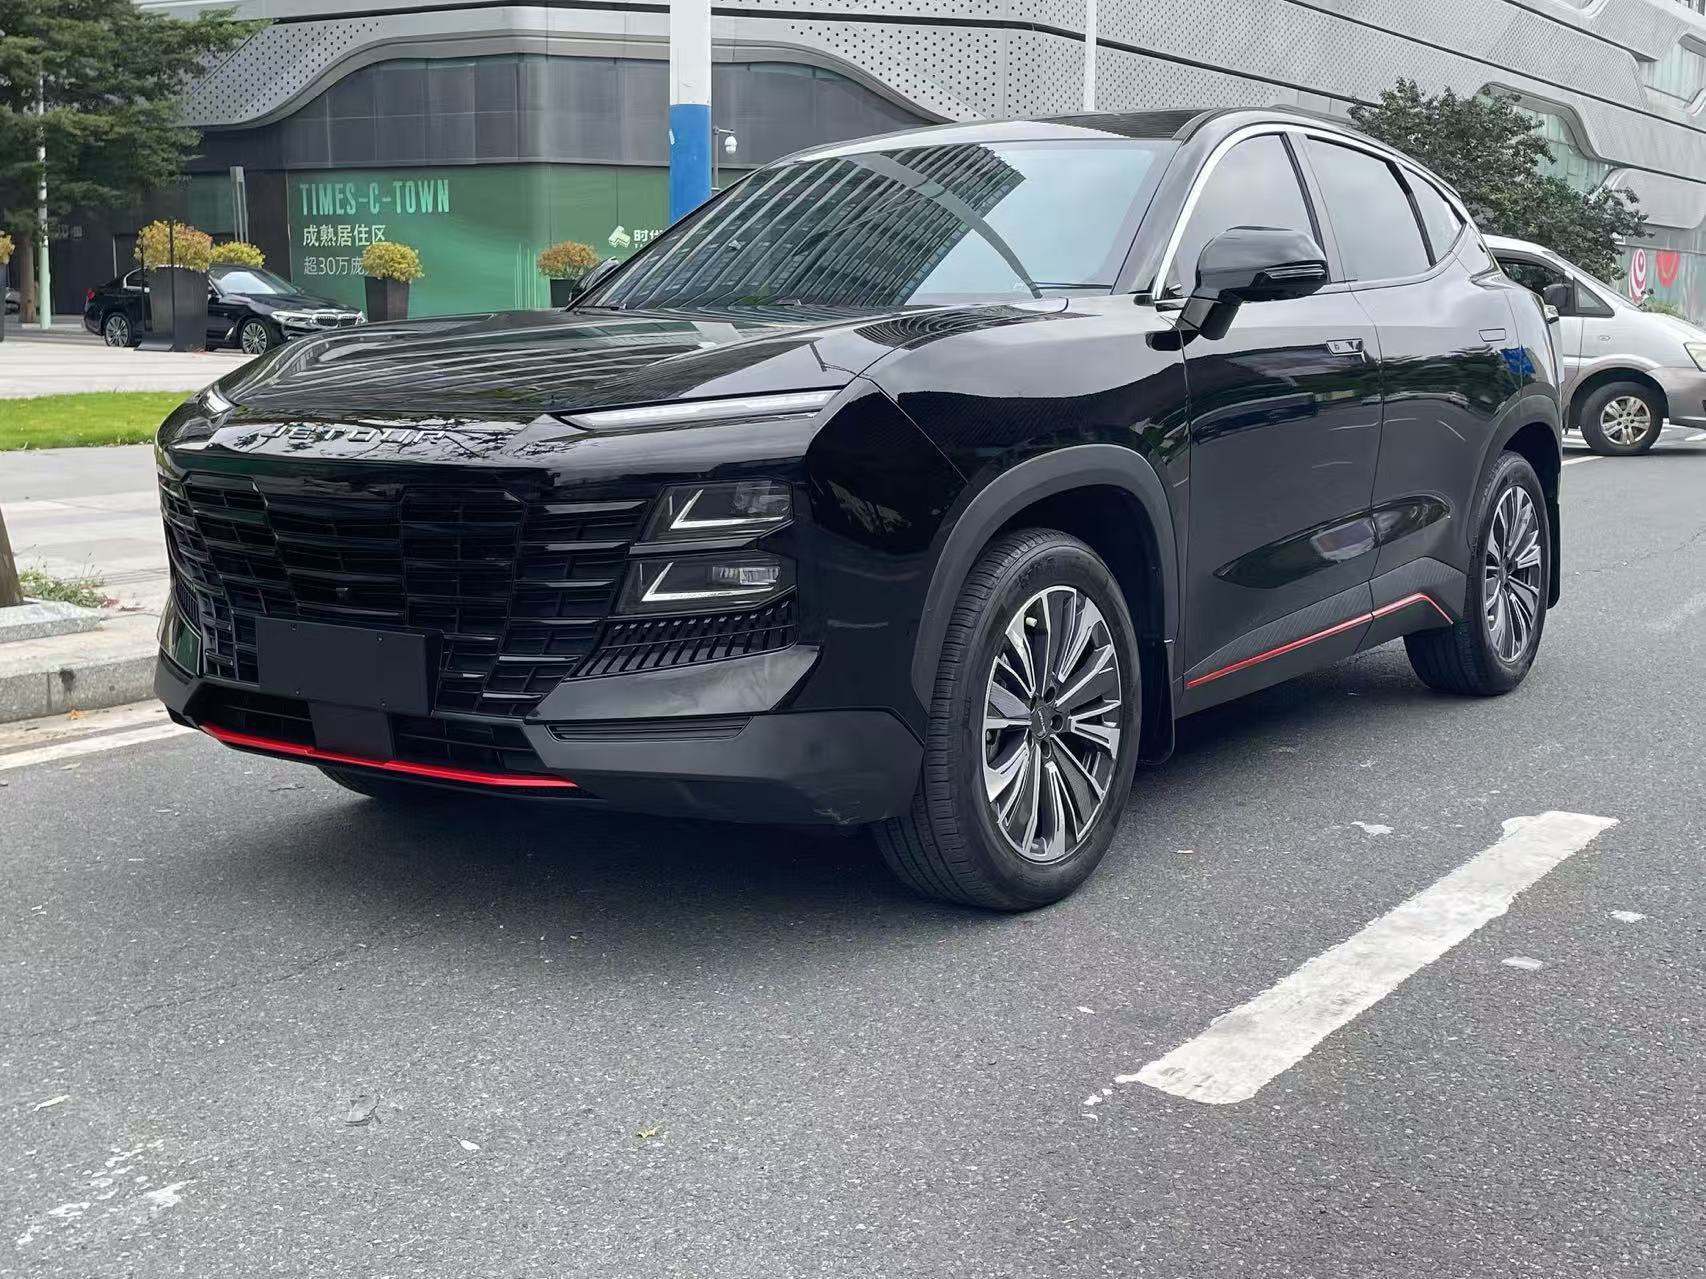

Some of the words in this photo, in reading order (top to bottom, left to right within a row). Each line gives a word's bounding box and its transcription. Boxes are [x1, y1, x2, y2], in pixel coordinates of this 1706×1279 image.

[300, 179, 450, 216] TIMES-C-TOWN
[303, 224, 387, 247] 成熟居住区
[304, 256, 369, 275] 超30万庞
[260, 424, 446, 444] JETOUR
